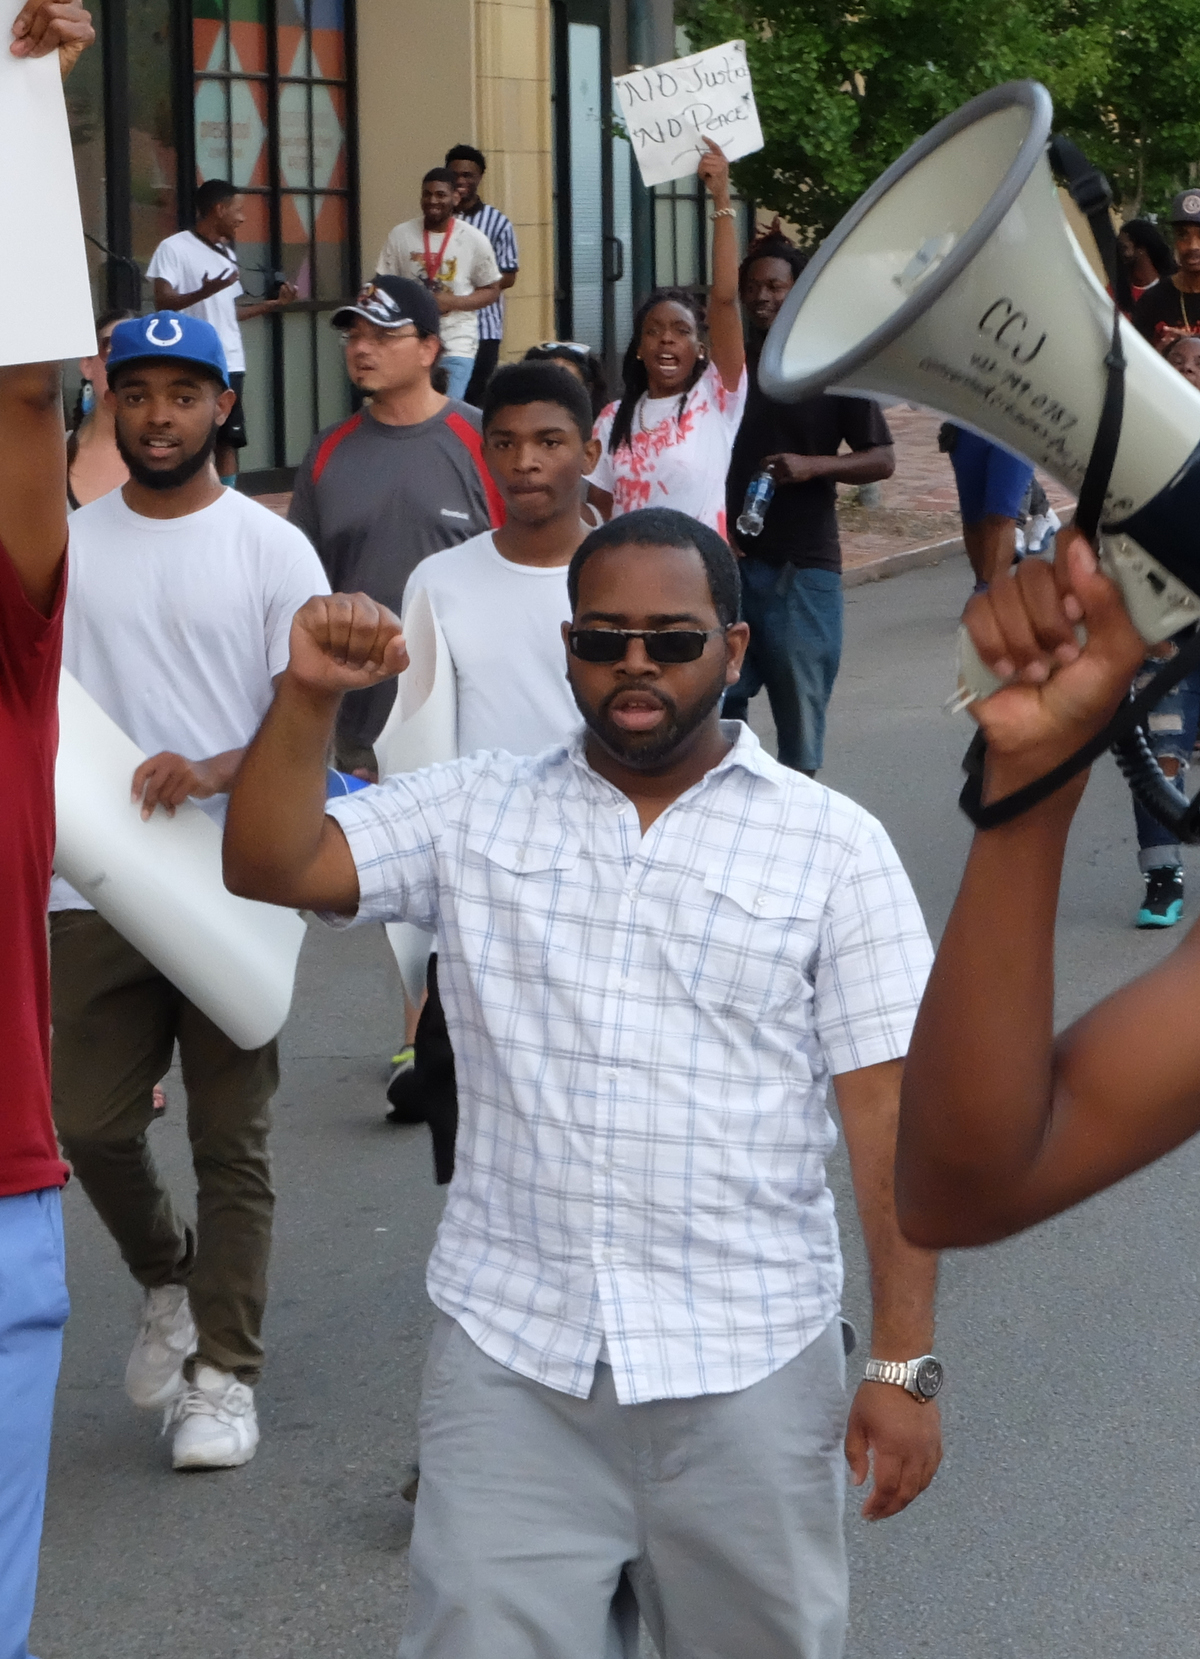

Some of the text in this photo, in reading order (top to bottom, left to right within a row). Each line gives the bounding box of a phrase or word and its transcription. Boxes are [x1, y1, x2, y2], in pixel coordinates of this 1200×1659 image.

[624, 73, 678, 107] NO
[638, 118, 682, 148] NO
[979, 297, 1047, 364] CCJ
